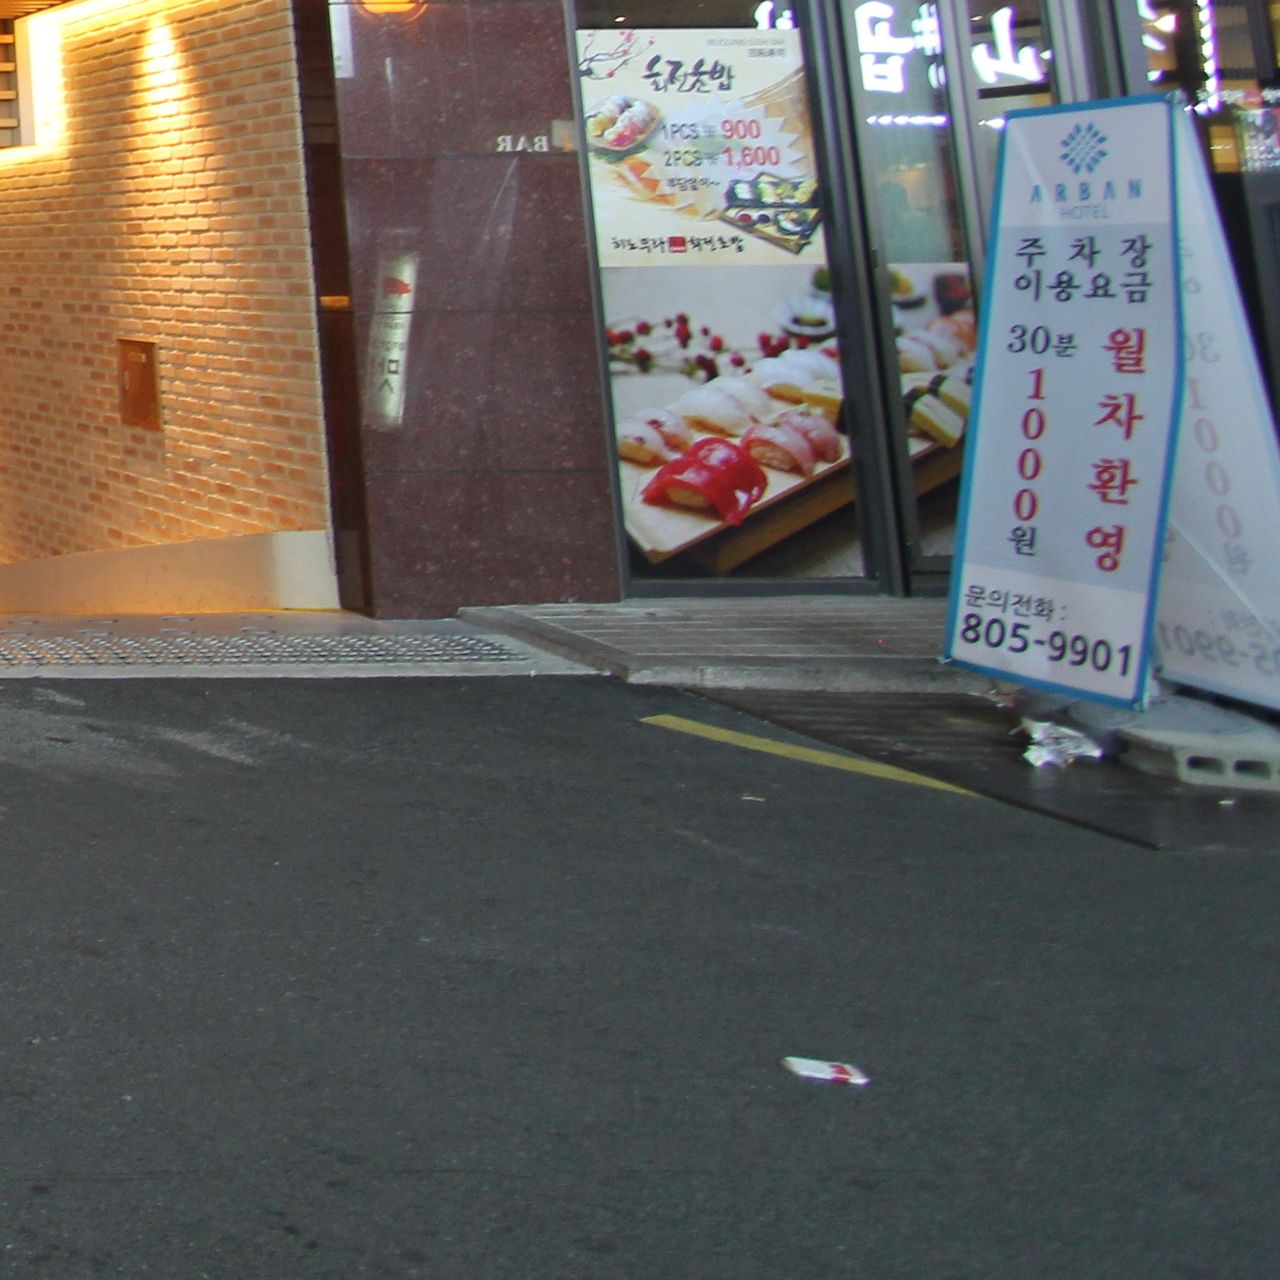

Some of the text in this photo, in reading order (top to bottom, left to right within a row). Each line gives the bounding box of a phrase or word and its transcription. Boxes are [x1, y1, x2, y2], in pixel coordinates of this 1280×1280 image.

[721, 119, 761, 140] 900
[723, 146, 782, 169] 1,600
[1030, 179, 1142, 203] ARBAN
[1059, 205, 1111, 220] HOTEL
[1013, 270, 1154, 304] 이용요금
[1007, 324, 1078, 358] 30분
[960, 612, 1133, 678] 805-9901
